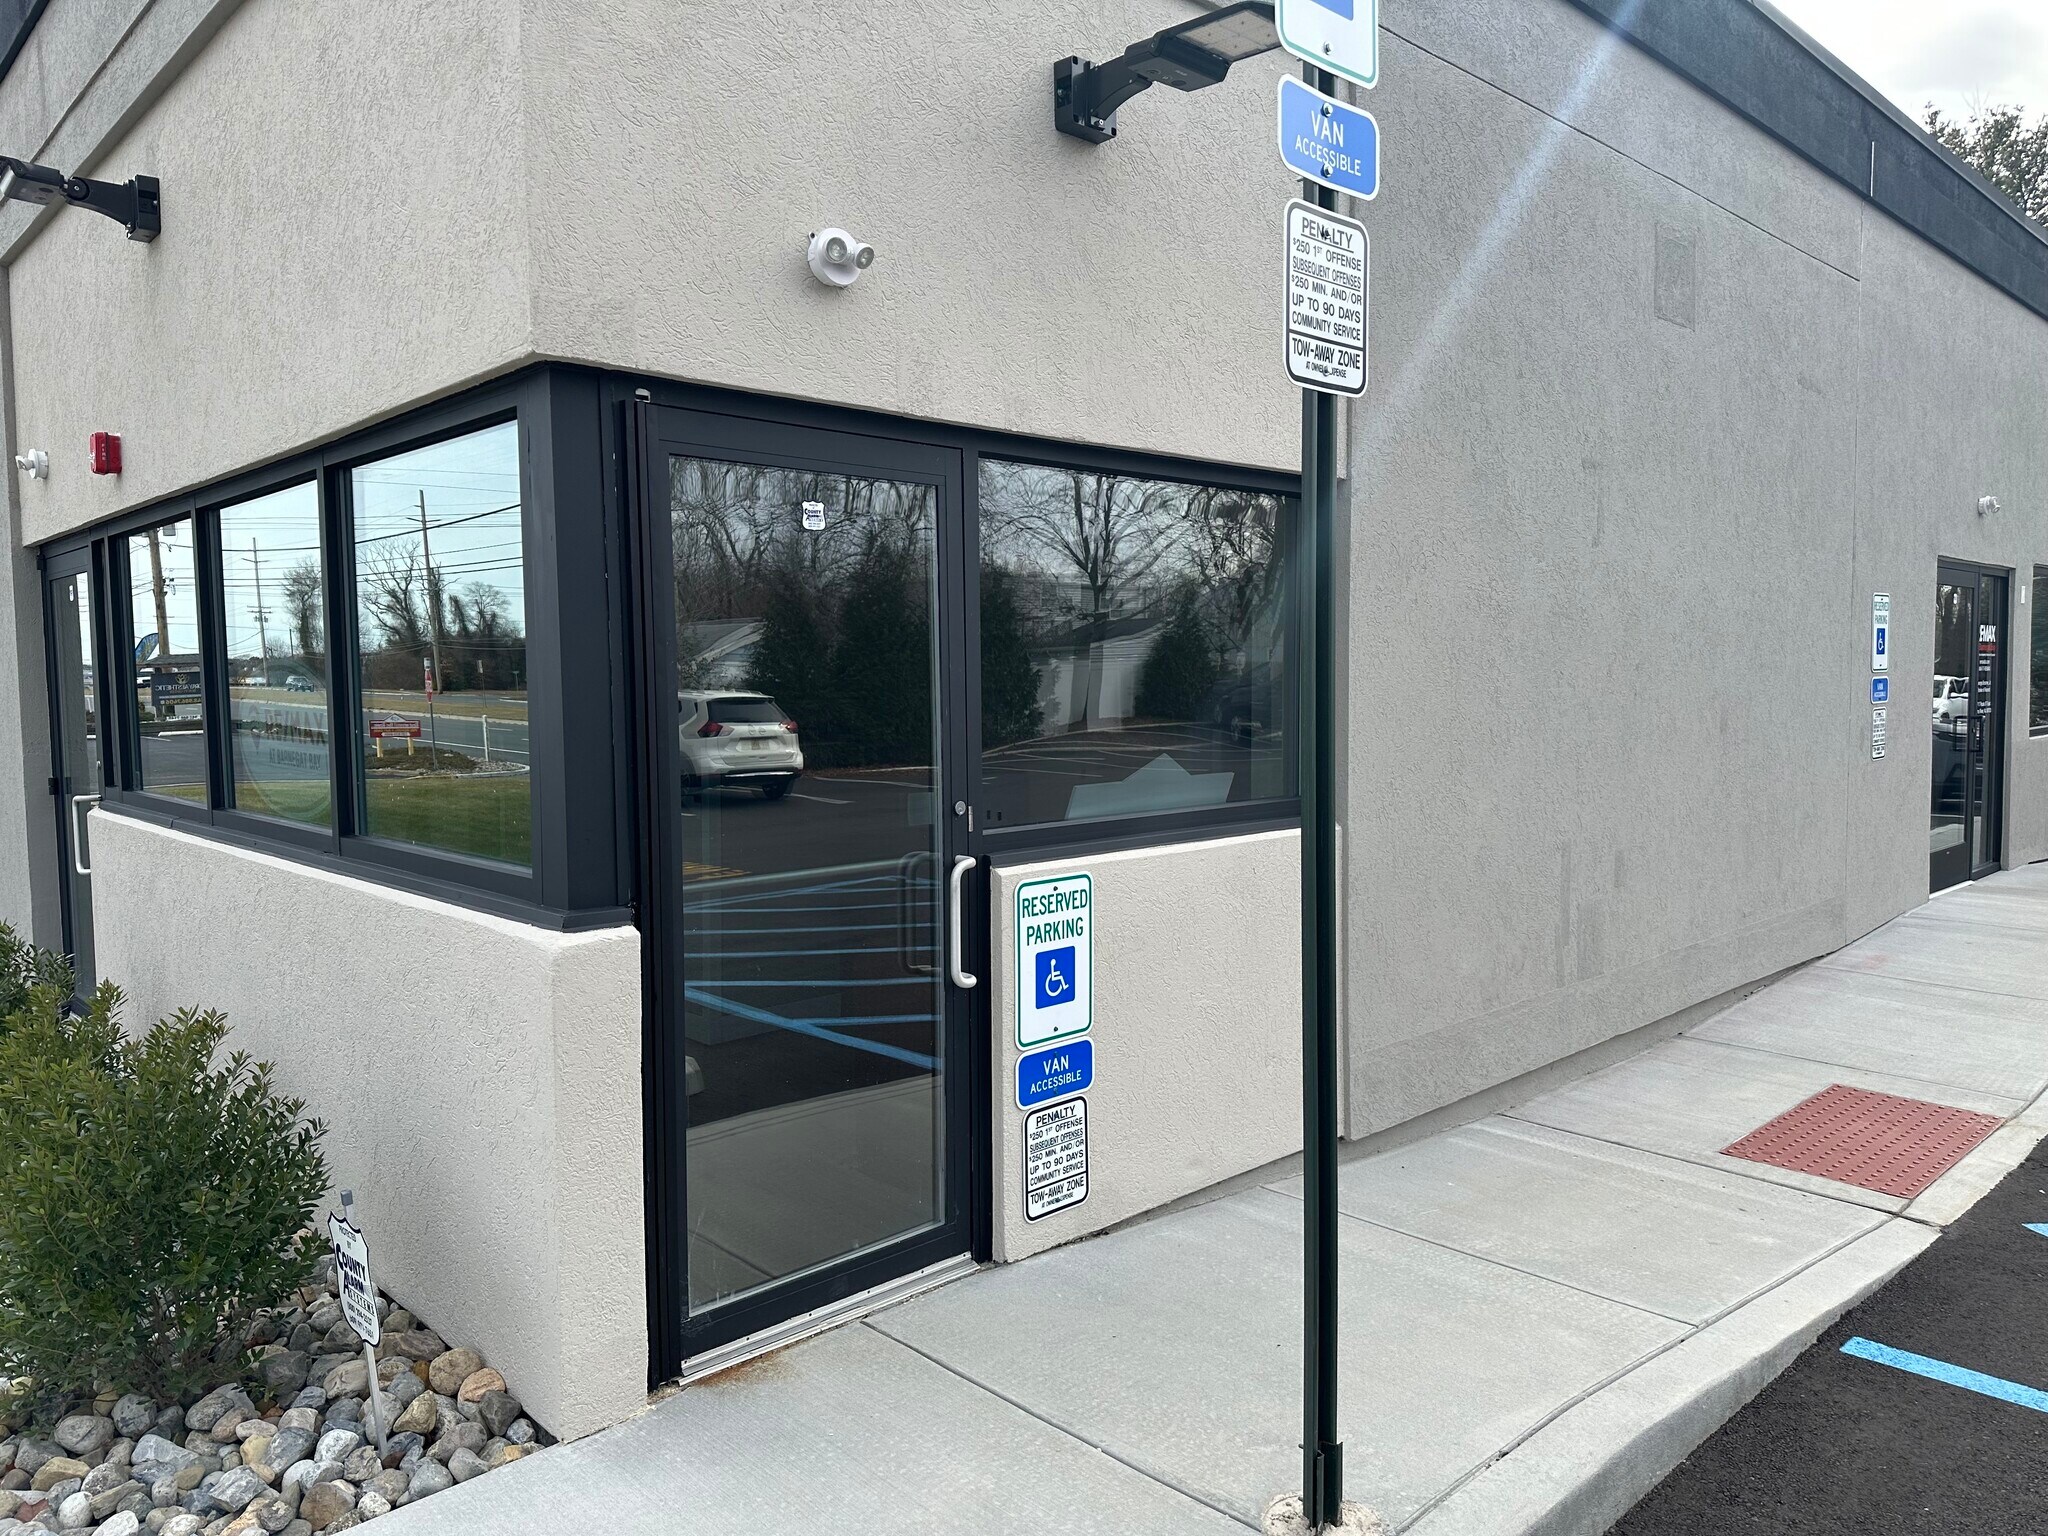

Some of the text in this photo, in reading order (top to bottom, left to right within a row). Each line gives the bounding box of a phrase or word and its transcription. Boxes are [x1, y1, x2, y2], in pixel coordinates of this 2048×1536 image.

[1311, 110, 1344, 147] VAN
[1295, 134, 1362, 176] ACCESSIBLE
[1302, 216, 1353, 249] PENALTY
[1292, 237, 1311, 255] $250
[1326, 249, 1362, 272] OFFENSE
[1292, 255, 1362, 289] SUBSEQUENT OFFENSES
[1291, 274, 1362, 306] $250 MIN. AND/OR
[1292, 292, 1361, 324] UP TO 90 DAYS
[1292, 311, 1361, 341] COMMUNITY SERVICE
[1292, 337, 1361, 370] TOW-AWAY ZONE
[263, 708, 327, 745] RE/MAX
[308, 753, 321, 770] BAY
[1022, 889, 1088, 918] RESERVED
[1026, 917, 1084, 946] PARKING
[1043, 1055, 1069, 1076] VAN
[1030, 1069, 1082, 1095] ACCESSIBLE
[1029, 1130, 1043, 1140] $250
[1055, 1117, 1083, 1132] OFFENSE
[1036, 1105, 1076, 1127] PENALTY
[1030, 1128, 1083, 1152] SUBSEQUENT OFFENSES
[1029, 1152, 1043, 1163] $250
[1030, 1150, 1084, 1175] UP TO 90 DAYS
[1030, 1160, 1084, 1187] COMMUNITY SERVICE
[1030, 1183, 1065, 1205] TOW-AWAY
[1066, 1176, 1085, 1192] ZONE
[335, 1243, 366, 1282] COUNTY
